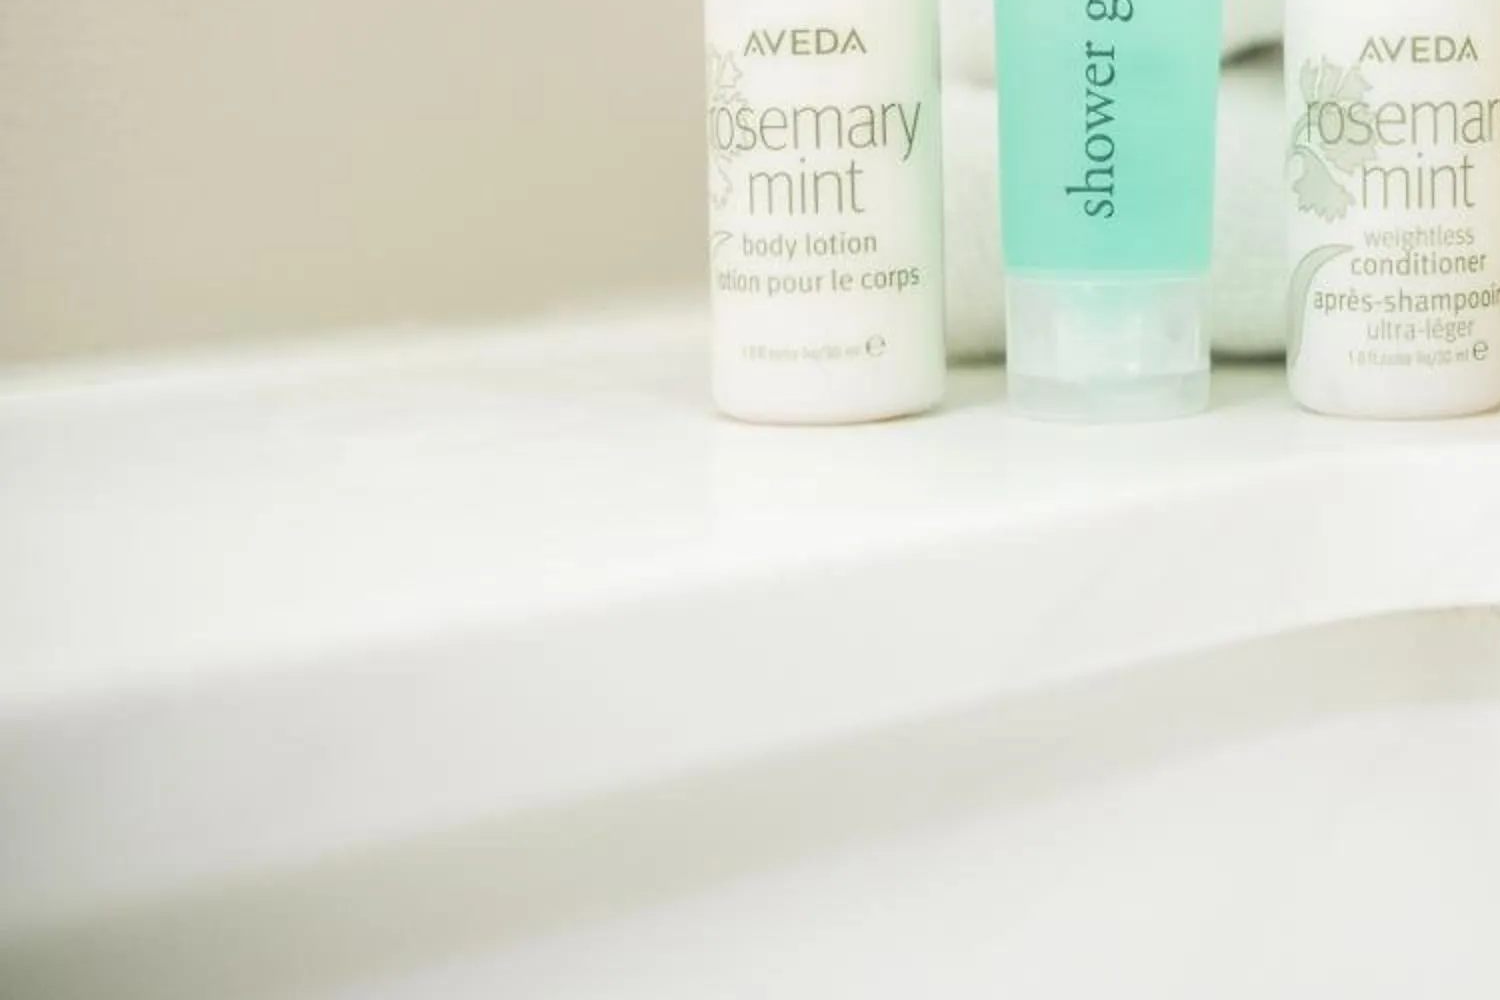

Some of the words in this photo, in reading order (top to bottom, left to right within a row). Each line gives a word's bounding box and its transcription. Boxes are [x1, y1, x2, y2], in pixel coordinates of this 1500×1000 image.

[744, 27, 867, 57] AVEDA
[1359, 35, 1479, 63] AVEDA
[1066, 40, 1116, 219] shower
[748, 157, 865, 215] mint
[1362, 152, 1476, 209] mint
[742, 232, 798, 260] body
[805, 231, 877, 257] lotion
[1363, 226, 1475, 252] weightless
[1351, 251, 1487, 277] conditioner
[767, 272, 823, 297] pour
[831, 268, 854, 292] le
[861, 265, 920, 294] corps
[1367, 317, 1475, 343] ultra-léger
